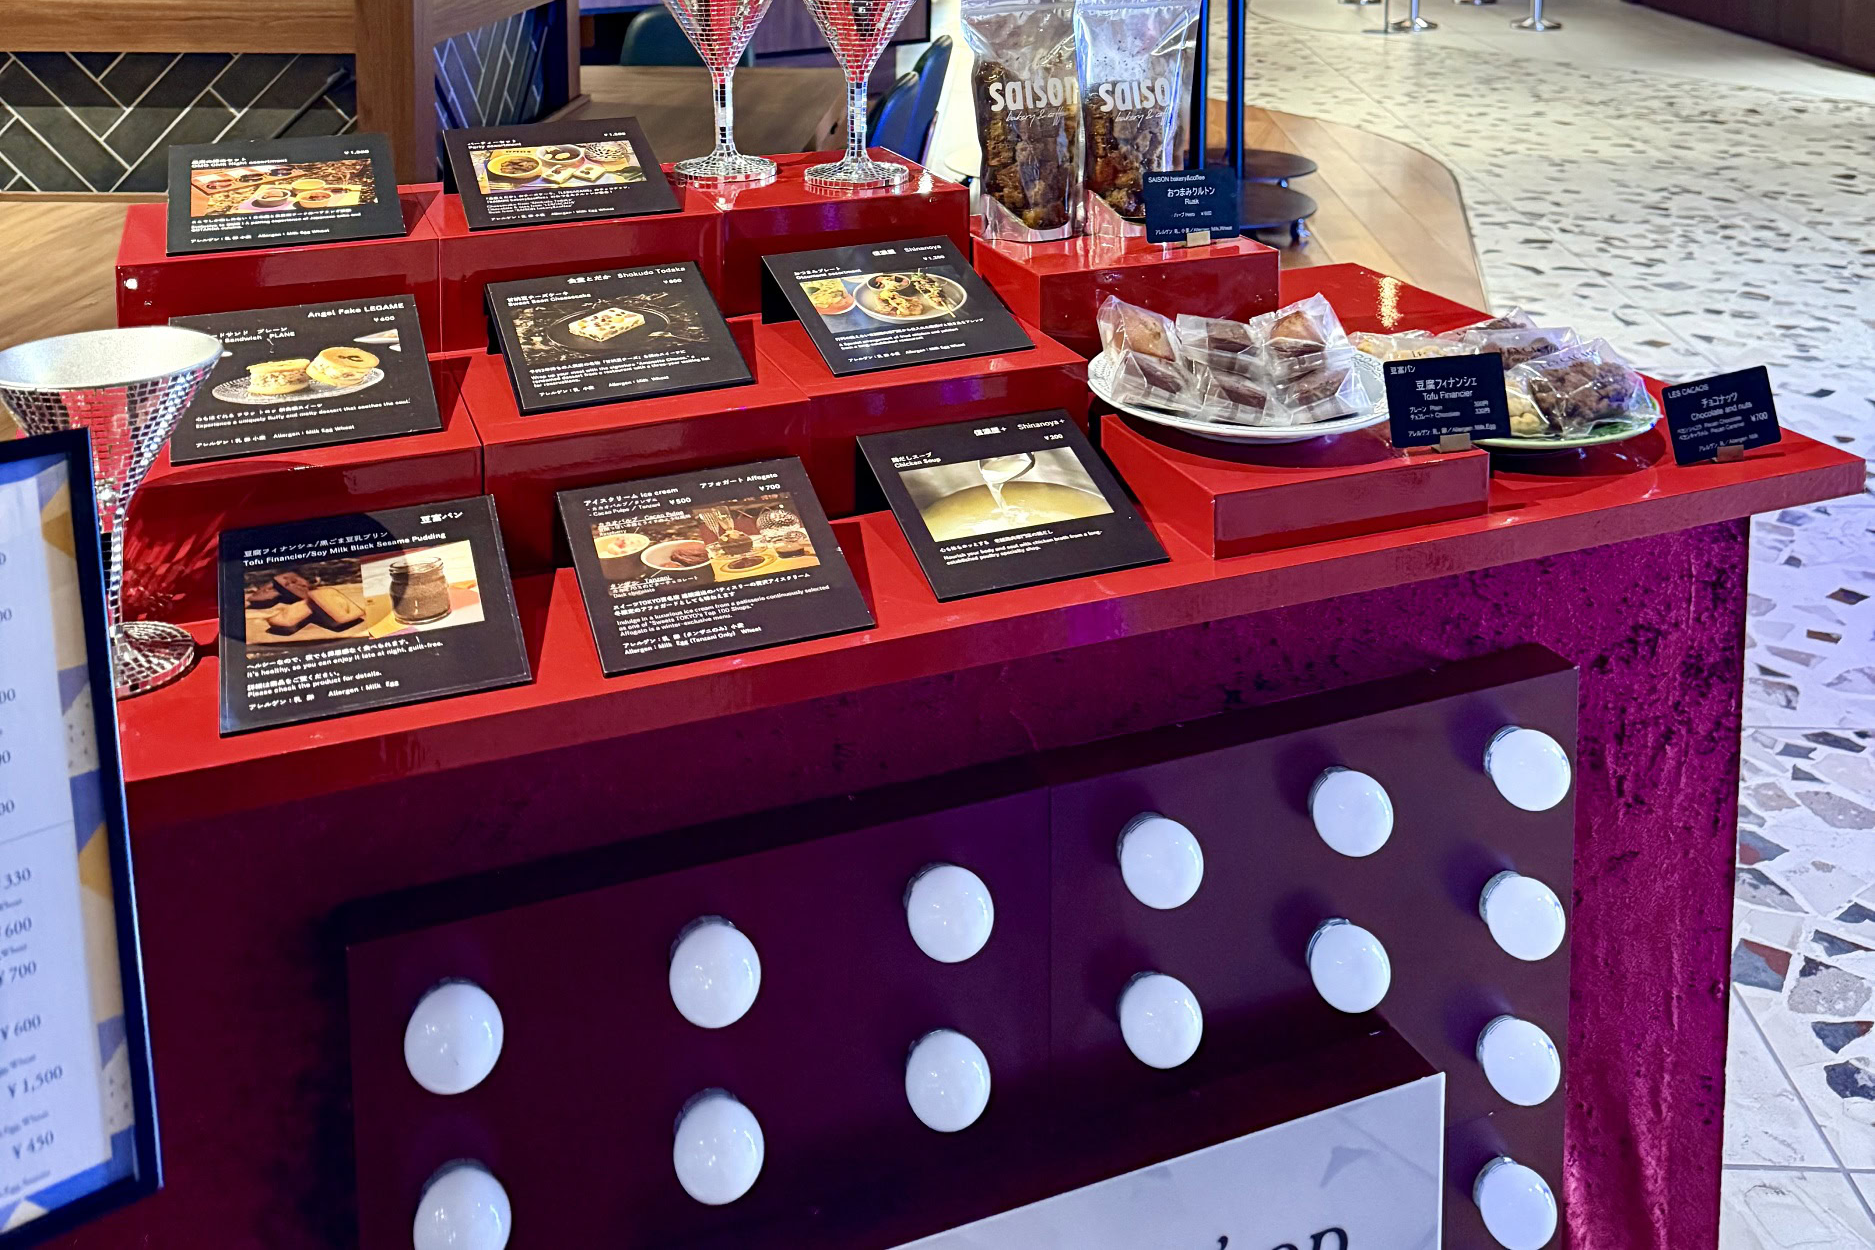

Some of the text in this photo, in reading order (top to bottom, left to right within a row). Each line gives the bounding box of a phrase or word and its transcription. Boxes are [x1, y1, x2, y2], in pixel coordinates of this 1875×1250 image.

[989, 77, 1079, 112] saison
[1099, 77, 1170, 112] saiso
[1006, 111, 1036, 127] bakery
[1114, 110, 1145, 127] bakery
[1167, 186, 1215, 198] おつまみクルトン
[904, 245, 942, 253] Shinanoya
[617, 270, 654, 279] Shokudo
[654, 266, 686, 274] Todaka
[307, 310, 336, 319] Angel
[224, 331, 296, 343] Sandwich PLANE
[1415, 376, 1478, 391] 豆腐フィナンシェ
[1667, 383, 1710, 399] LES CACAOS
[1422, 390, 1473, 401] Tofu Financier
[1701, 392, 1738, 409] チョコナッツ
[1690, 408, 1724, 421] Chocolate
[1725, 404, 1738, 413] and
[195, 420, 232, 429] Experience
[238, 416, 266, 425] uniquely
[894, 456, 942, 469] Chicken Soup
[699, 472, 778, 489] アフォガート Affogato
[583, 493, 638, 507] アイスクリーム
[653, 487, 679, 496] cream
[243, 532, 447, 567] Tofu Financier/Soy Milk Black Sesame Pudding
[616, 618, 640, 626] Indulge
[694, 604, 715, 613] cream
[715, 601, 730, 609] from
[804, 585, 830, 594] selected
[704, 610, 716, 618] Top
[620, 628, 648, 637] Affogato
[624, 646, 653, 655] Allergen
[740, 626, 762, 634] Wheat
[302, 661, 317, 670] you
[333, 655, 353, 664] enjoy
[247, 689, 273, 698] Please
[273, 684, 297, 693] check
[297, 681, 311, 689] the
[312, 676, 341, 687] product
[328, 686, 359, 698] Allergen
[365, 682, 382, 691] Milk
[4, 867, 31, 890] 330
[5, 916, 32, 938] 600
[9, 960, 37, 983] 700
